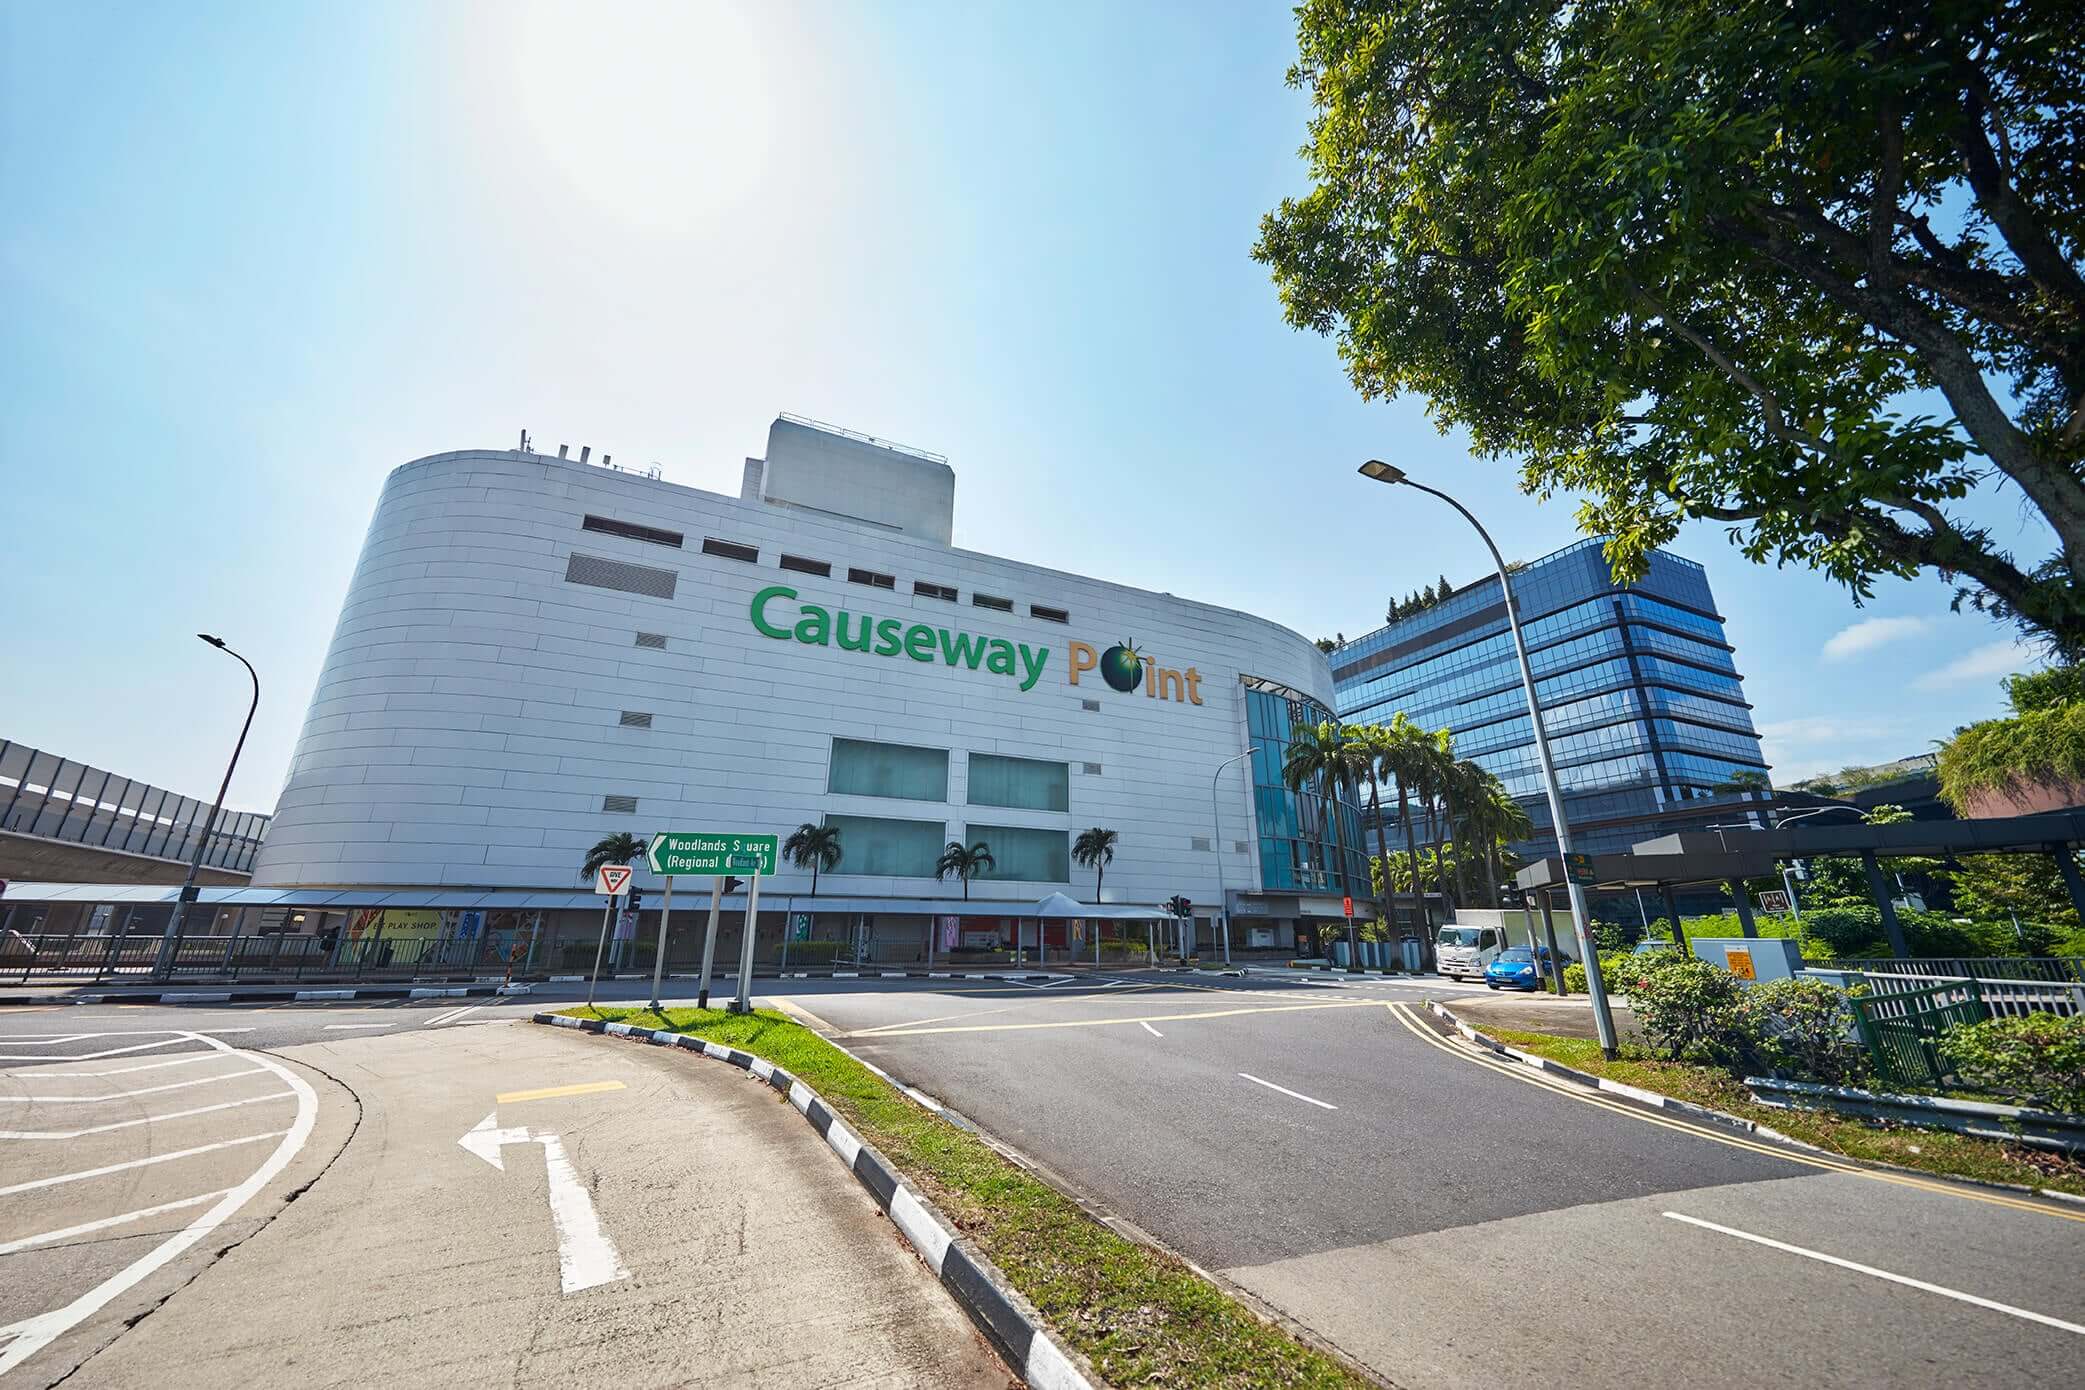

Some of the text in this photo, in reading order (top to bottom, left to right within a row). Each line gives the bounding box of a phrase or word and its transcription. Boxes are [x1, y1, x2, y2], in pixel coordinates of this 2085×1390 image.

[750, 585, 1203, 706] Causeway Point
[669, 838, 770, 851] Woodlands Suare
[667, 854, 719, 870] (Regional
[388, 922, 409, 930] PLAY
[410, 922, 437, 930] SHOP
